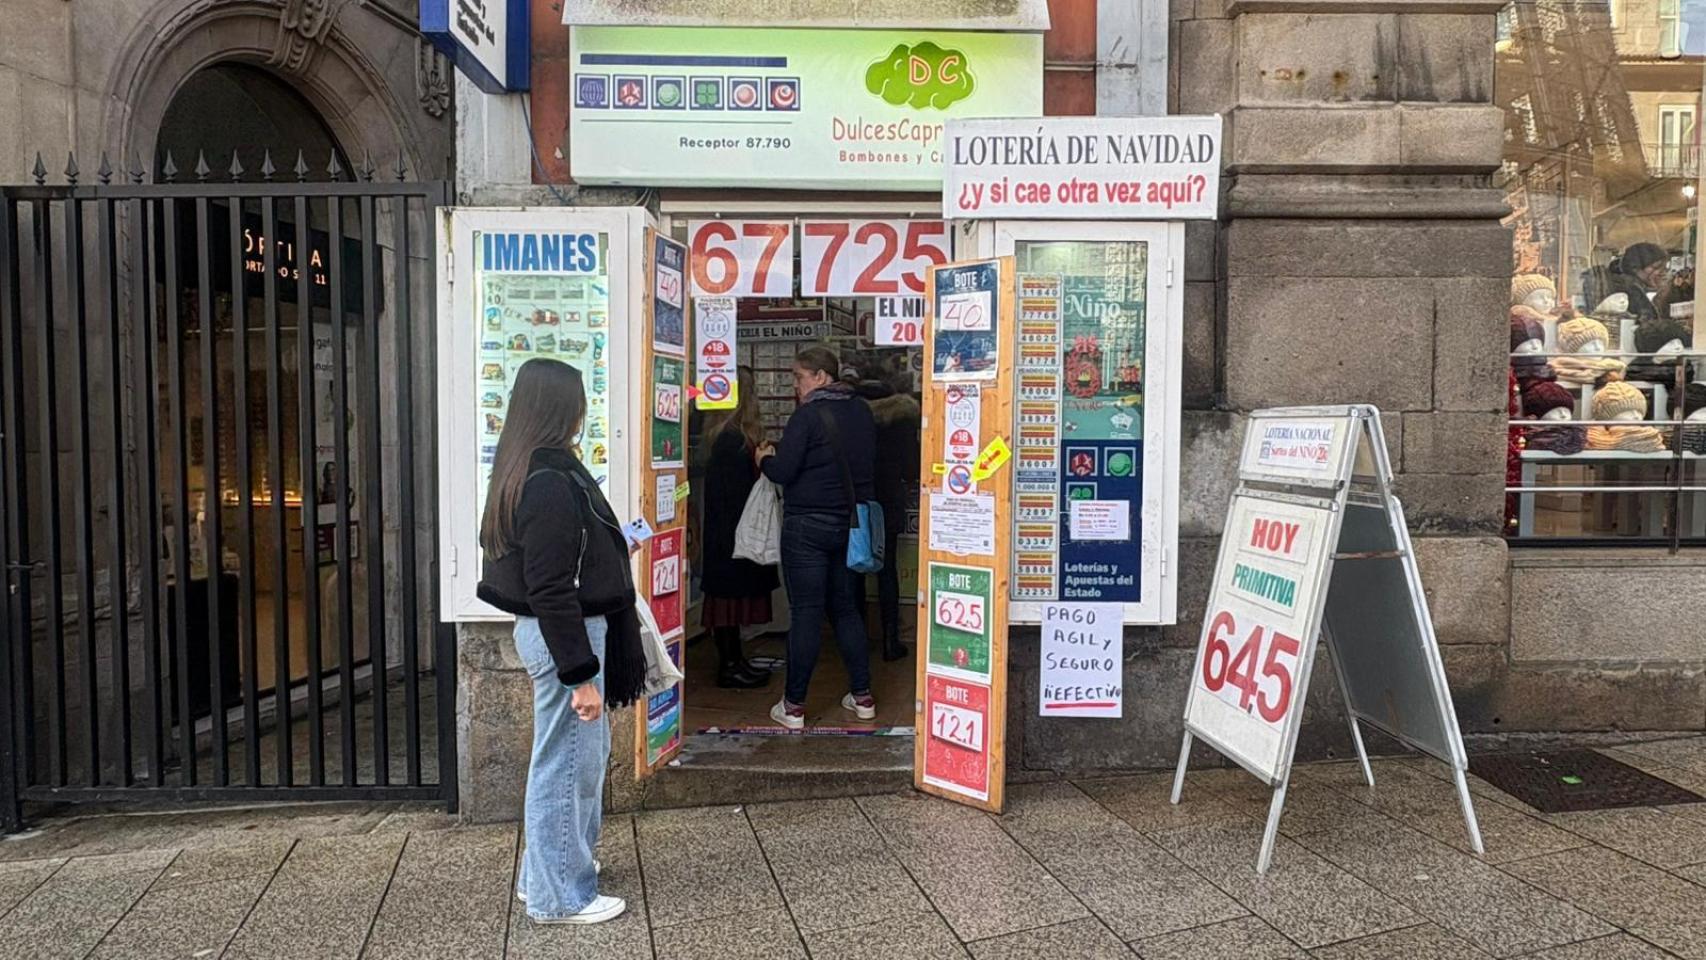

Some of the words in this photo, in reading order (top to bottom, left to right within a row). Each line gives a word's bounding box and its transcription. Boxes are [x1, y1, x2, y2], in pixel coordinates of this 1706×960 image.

[679, 137, 739, 150] Receptor
[746, 138, 791, 149] 87.790
[954, 127, 1060, 165] LOTERÍA
[1067, 135, 1098, 165] DE
[1107, 134, 1214, 164] NAVIDAD
[839, 151, 908, 162] Bombones
[917, 154, 922, 164] y
[958, 182, 984, 210] ¿y
[990, 177, 1008, 203] si
[1014, 182, 1051, 203] cae
[1057, 178, 1098, 203] otra
[1105, 182, 1141, 203] vez
[1146, 175, 1206, 209] aquí?
[483, 233, 596, 272] IMANES
[955, 271, 977, 288] BOTE
[880, 298, 897, 317] EL
[763, 327, 778, 337] EL
[1250, 518, 1300, 554] HOY
[1064, 562, 1108, 573] Loterías
[1111, 564, 1118, 575] y
[949, 573, 971, 589] BOTE
[1065, 576, 1114, 588] Apuestas
[1116, 575, 1133, 585] del
[1231, 563, 1296, 608] PRIMITIVA
[1064, 588, 1101, 597] Estado
[1047, 606, 1096, 625] PAGO
[1054, 629, 1098, 646] AGIL
[1046, 652, 1114, 671] SEGURO
[945, 685, 969, 703] BOTE
